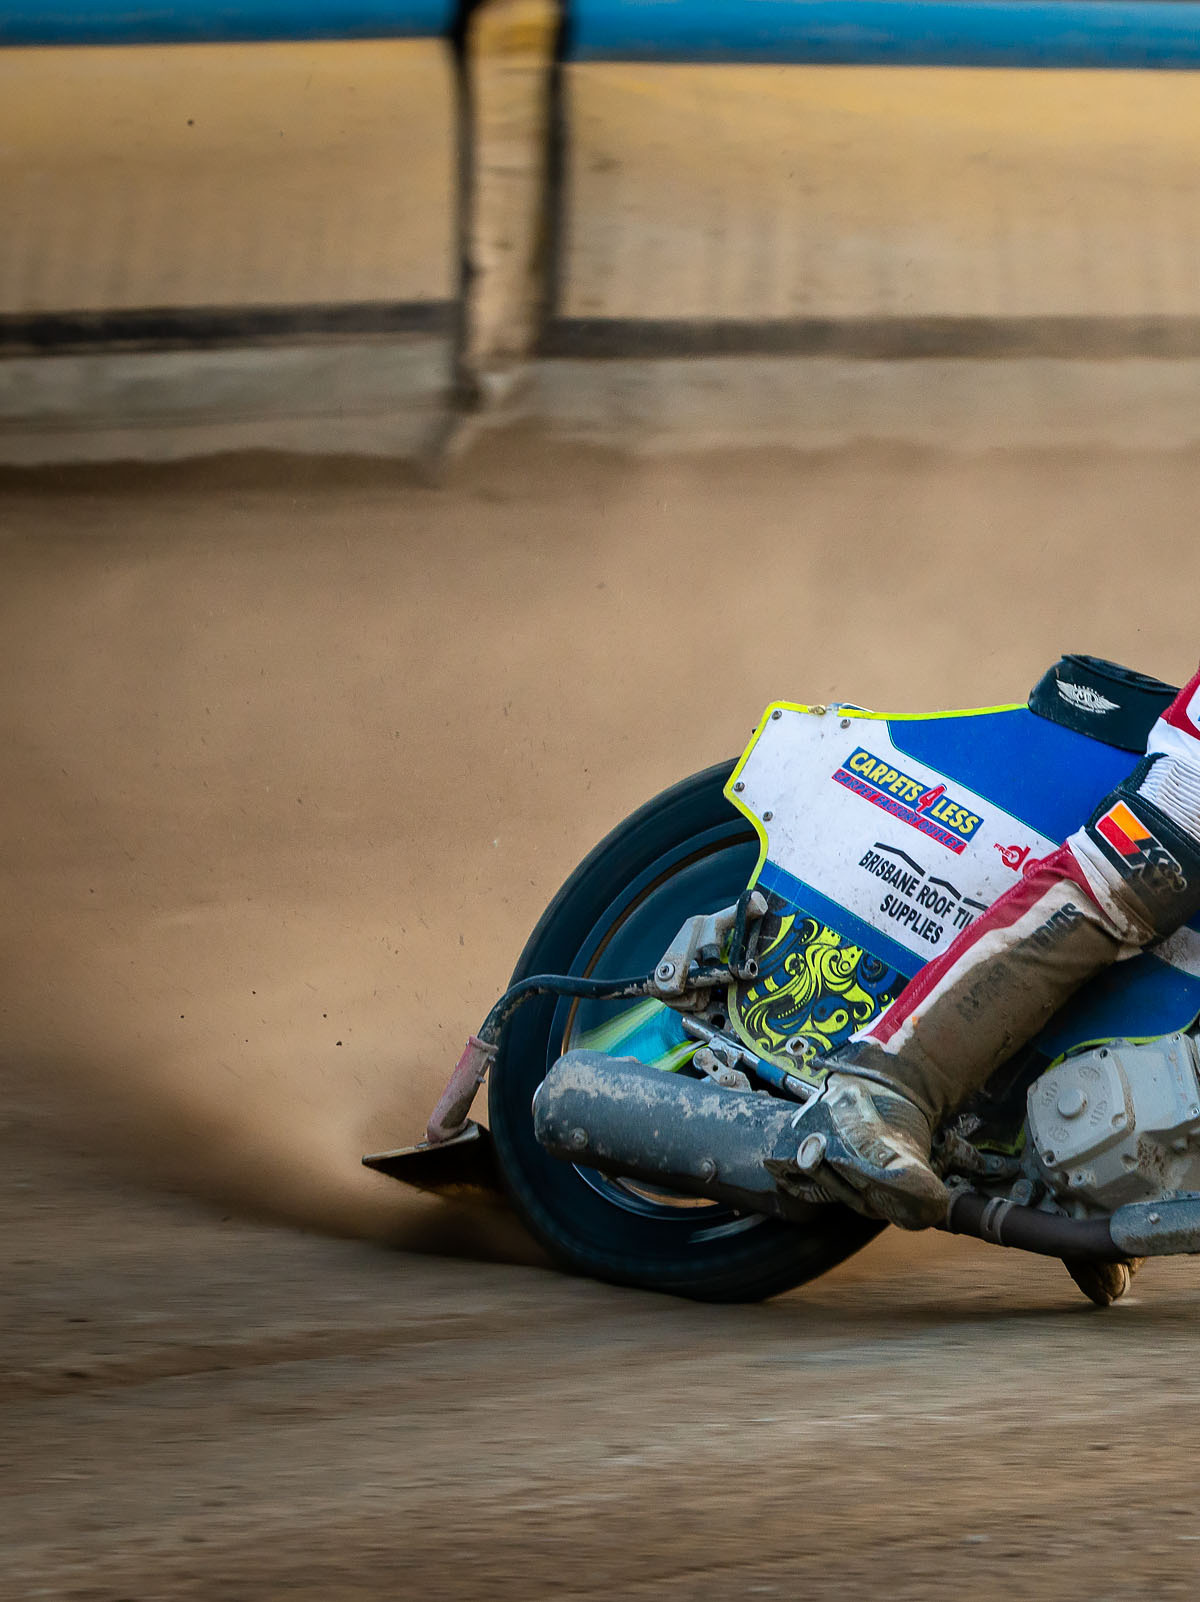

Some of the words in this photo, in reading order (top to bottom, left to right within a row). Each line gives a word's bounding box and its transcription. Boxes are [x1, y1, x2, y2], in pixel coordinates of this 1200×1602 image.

[849, 752, 924, 802] CARPETS
[916, 784, 947, 814] 4
[834, 771, 879, 799] CARPET
[873, 795, 923, 825] FACTORY
[918, 821, 964, 850] OUTLET
[930, 798, 979, 834] LESS
[858, 849, 920, 898] BRISBANE
[916, 884, 956, 918] ROOF
[880, 894, 944, 944] SUPPLIES
